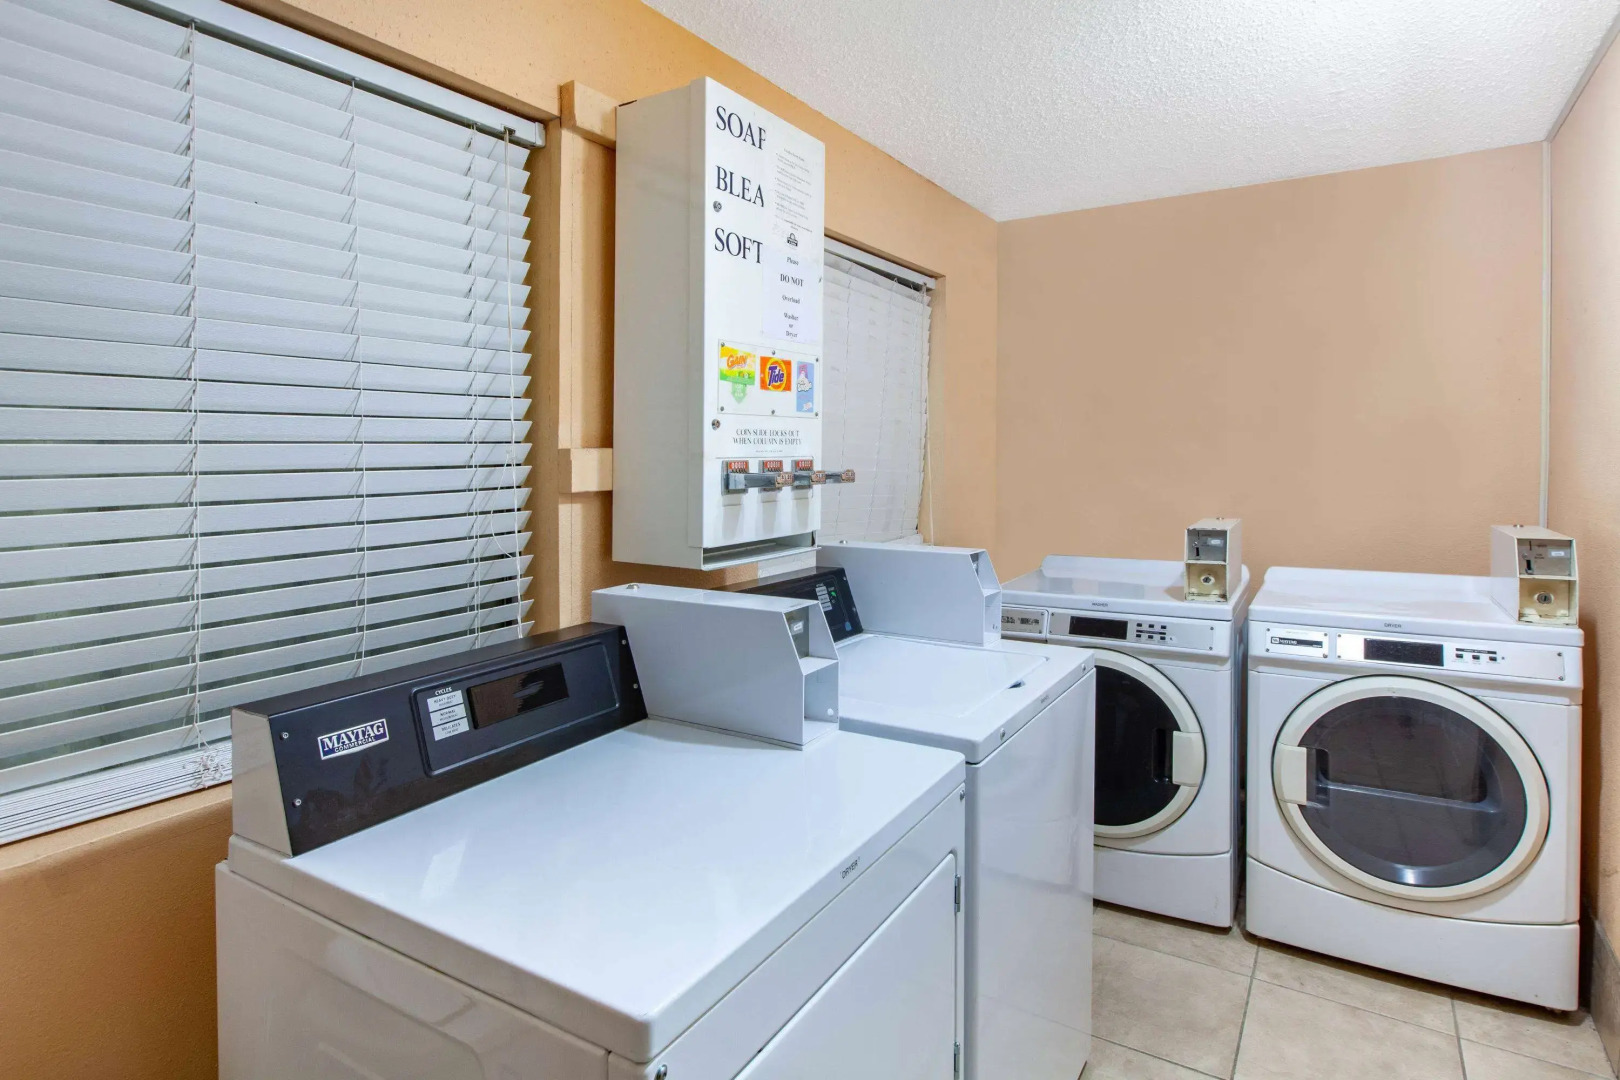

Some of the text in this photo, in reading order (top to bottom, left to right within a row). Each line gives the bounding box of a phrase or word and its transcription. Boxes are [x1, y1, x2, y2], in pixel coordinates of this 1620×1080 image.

[714, 227, 763, 264] SOFT
[780, 274, 804, 287] DO NOT
[781, 294, 801, 304] Overload
[783, 312, 799, 321] Washer
[768, 365, 785, 387] Tide
[736, 428, 752, 436] COIN
[753, 429, 768, 437] SLIDE
[733, 437, 752, 445] WHEN
[785, 438, 802, 446] EMPTY
[434, 687, 453, 696] CYCLES
[322, 722, 384, 751] MAYTAG
[334, 737, 376, 753] COMMERCIAL
